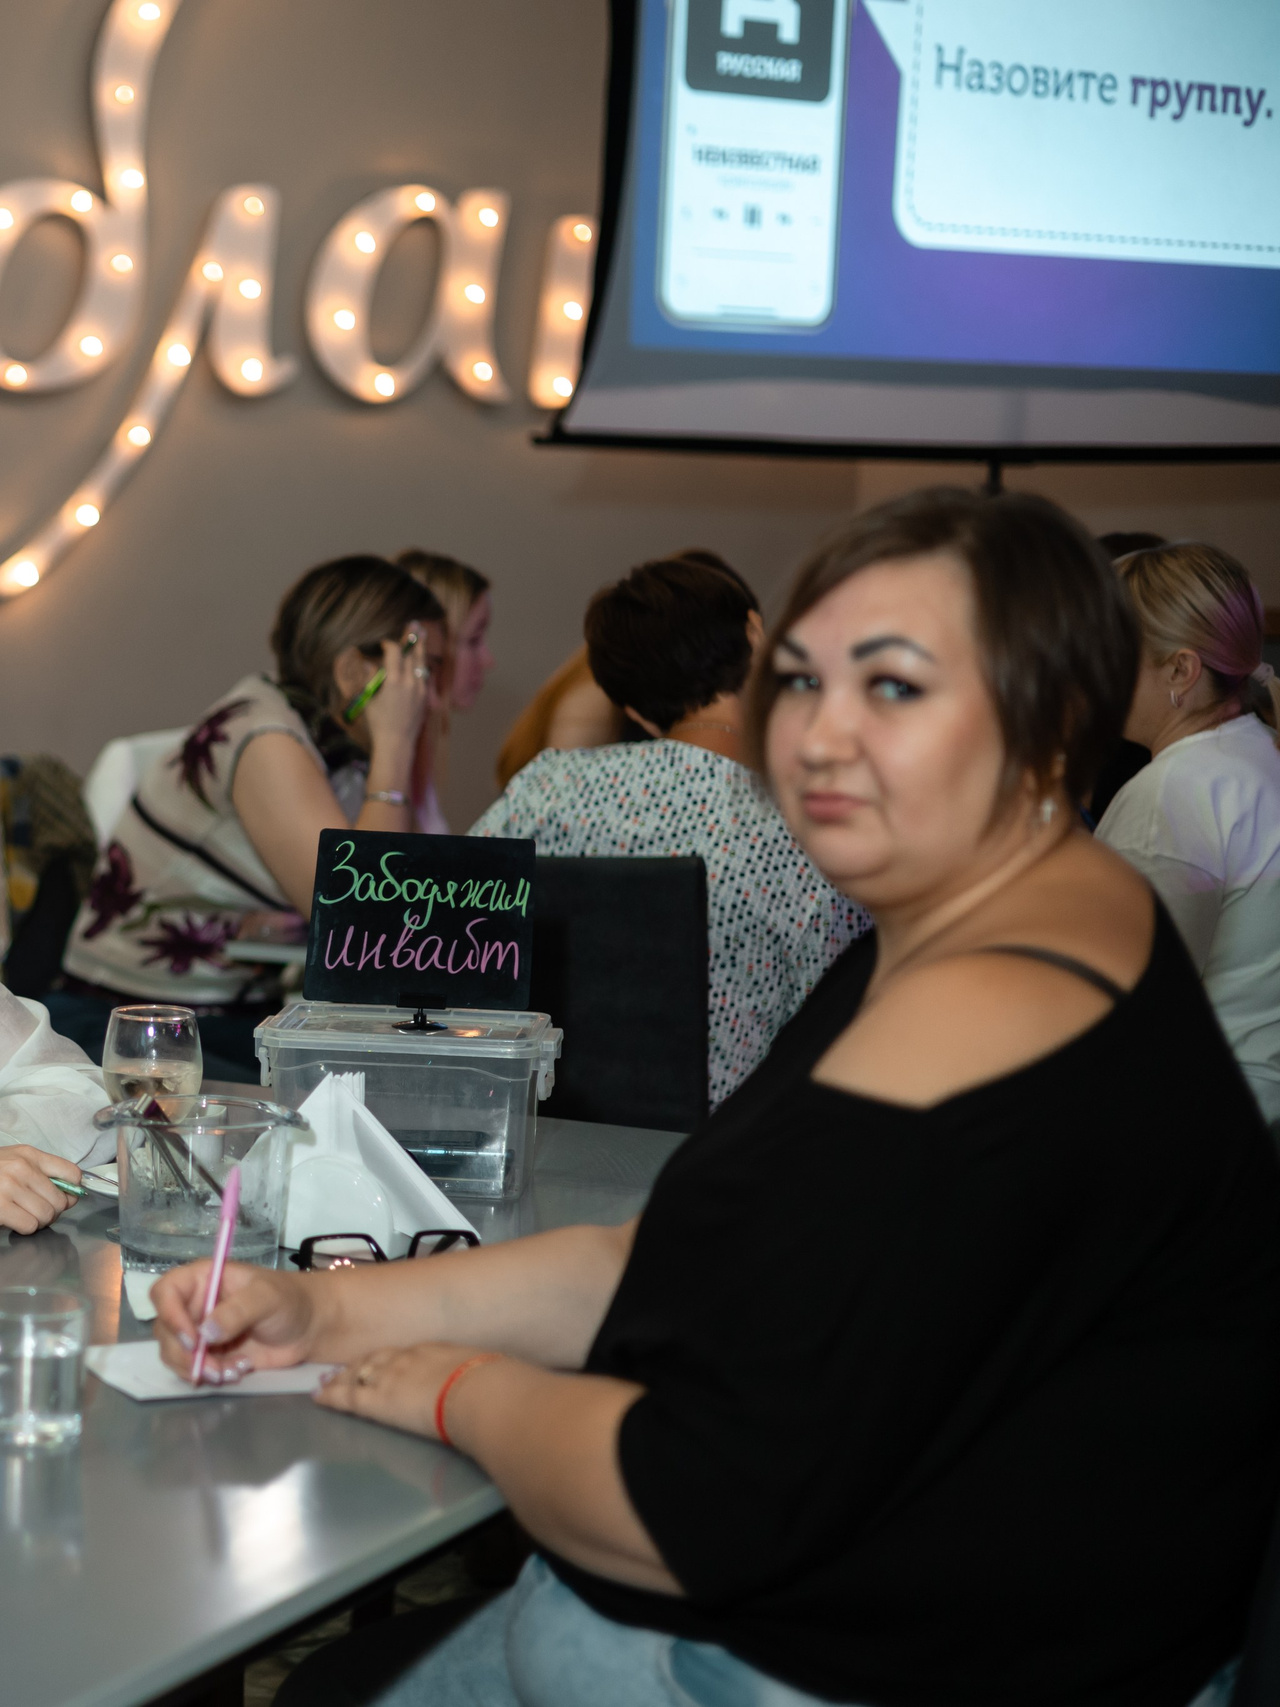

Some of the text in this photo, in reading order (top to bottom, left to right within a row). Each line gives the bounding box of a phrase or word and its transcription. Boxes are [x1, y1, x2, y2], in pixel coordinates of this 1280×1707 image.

[934, 43, 1274, 127] Назовите группу.
[319, 840, 531, 930] Забодяжим
